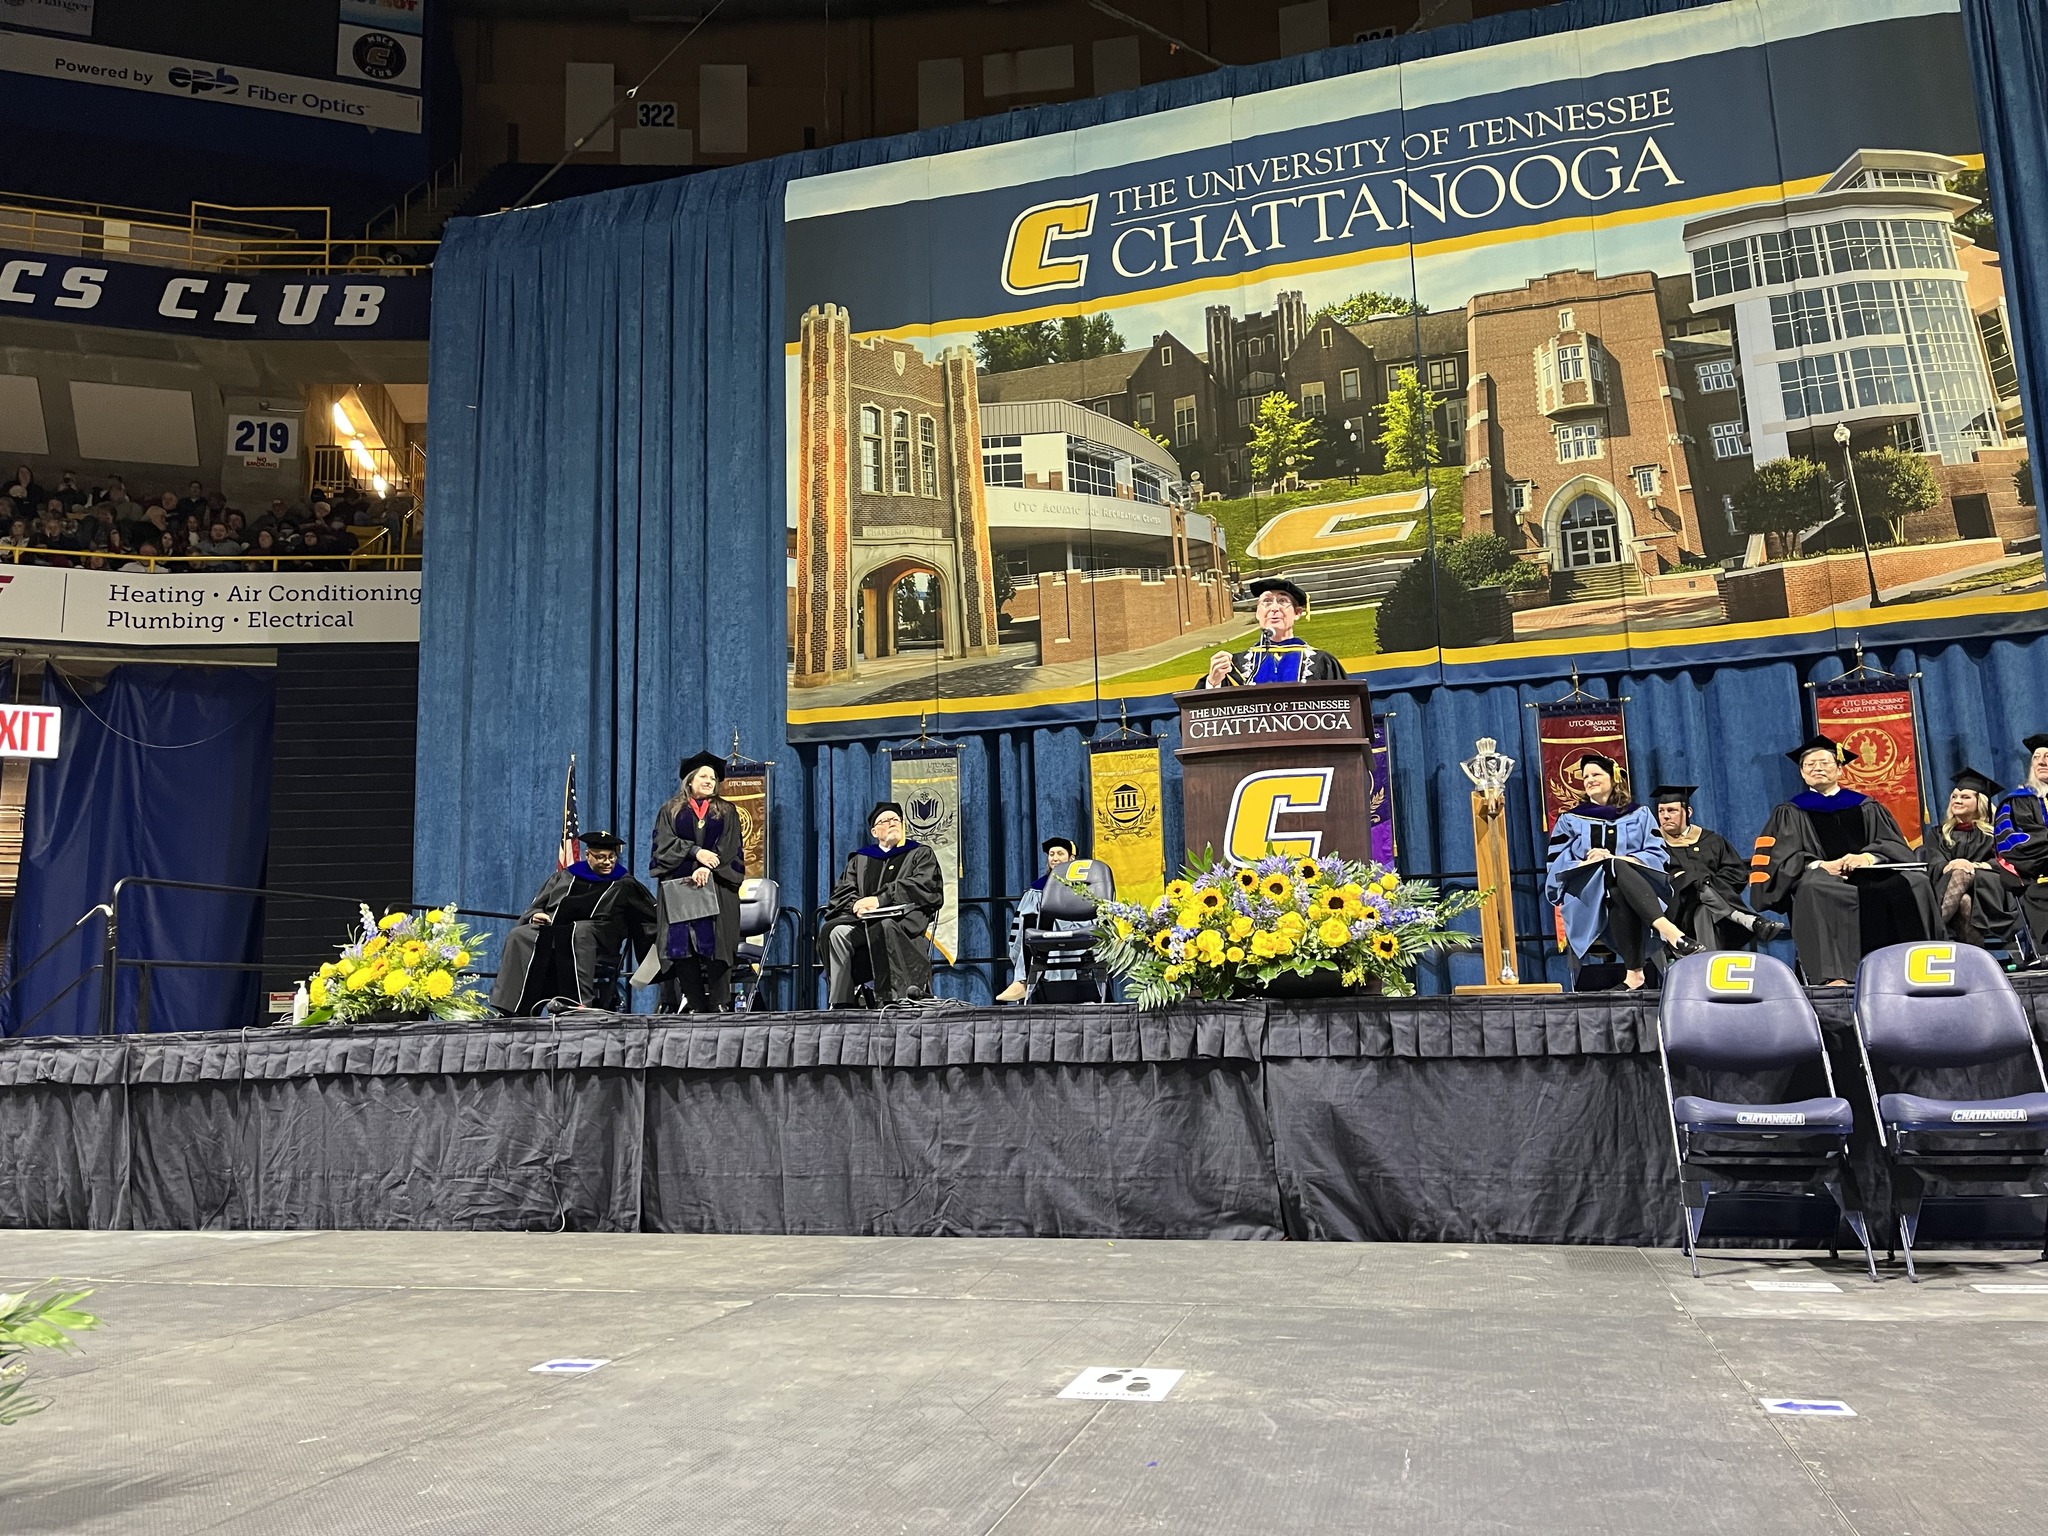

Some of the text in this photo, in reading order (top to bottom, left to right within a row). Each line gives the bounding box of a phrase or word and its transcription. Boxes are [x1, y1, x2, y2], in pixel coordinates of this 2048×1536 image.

[55, 58, 128, 79] Powered
[133, 70, 153, 85] by
[168, 67, 240, 95] epb
[247, 84, 298, 104] Fiber
[364, 65, 393, 77] CLUB
[639, 104, 675, 127] 322
[1109, 88, 1675, 215] THE UNIVERSITY OF TENNESSEE
[1112, 136, 1685, 278] CHATTANOOGA
[0, 260, 387, 326] CS CLUB
[235, 420, 289, 454] 219
[1013, 501, 1038, 513] UTC
[1042, 502, 1081, 515] AQUATIC
[1102, 508, 1141, 522] RECREATION
[1142, 513, 1162, 525] CENTER
[108, 584, 422, 607] Heating Air Conditioning
[106, 610, 354, 633] Plumbing Electrical
[1189, 700, 1351, 720] THE UNIVERSITY OF TENNESSEE
[1189, 713, 1353, 739] CHATTANOOGA
[1706, 953, 1757, 993] C
[1904, 944, 1957, 986] C
[1740, 1112, 1804, 1125] CHATTANOOGA
[1954, 1109, 2025, 1121] CHATTANOOGA
